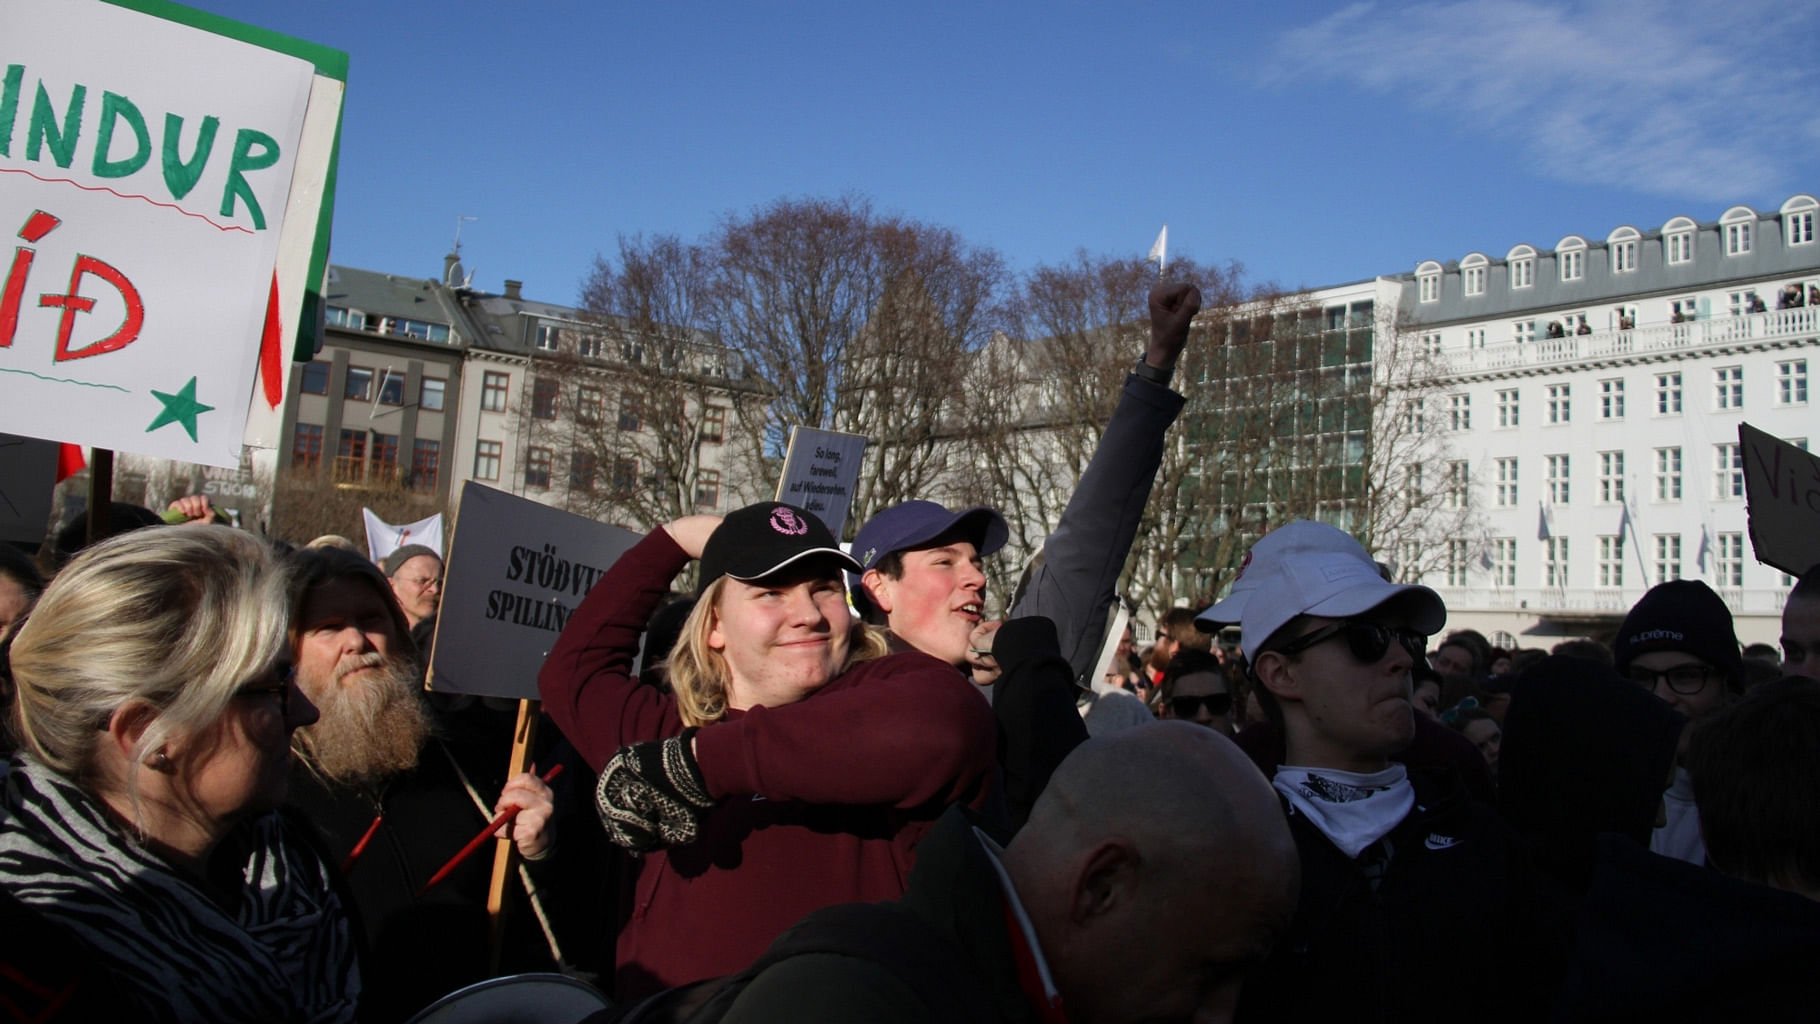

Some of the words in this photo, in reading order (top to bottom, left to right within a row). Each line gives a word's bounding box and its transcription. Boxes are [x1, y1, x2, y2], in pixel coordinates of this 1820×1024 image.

[815, 446, 824, 458] So
[790, 481, 803, 492] auf
[507, 543, 606, 595] STÖÐVU
